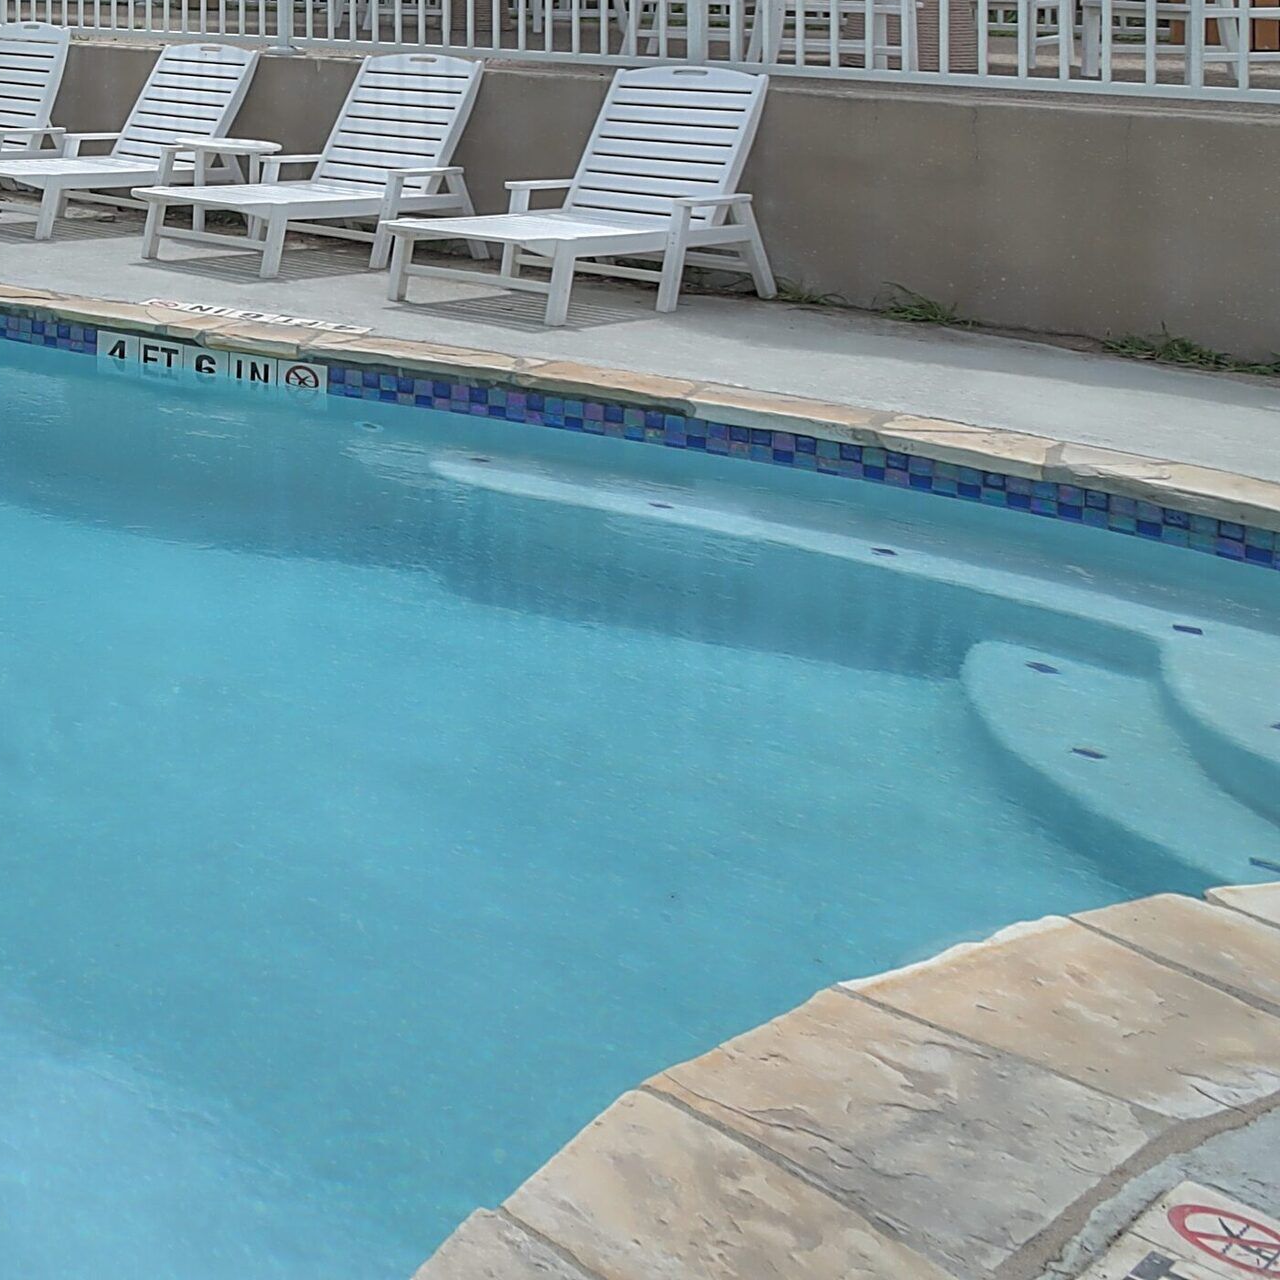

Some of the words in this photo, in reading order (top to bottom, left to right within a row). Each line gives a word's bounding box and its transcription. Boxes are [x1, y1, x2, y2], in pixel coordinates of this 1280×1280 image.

[108, 340, 126, 359] 4
[143, 344, 179, 368] FT
[195, 354, 216, 374] 6
[236, 359, 269, 383] IN
